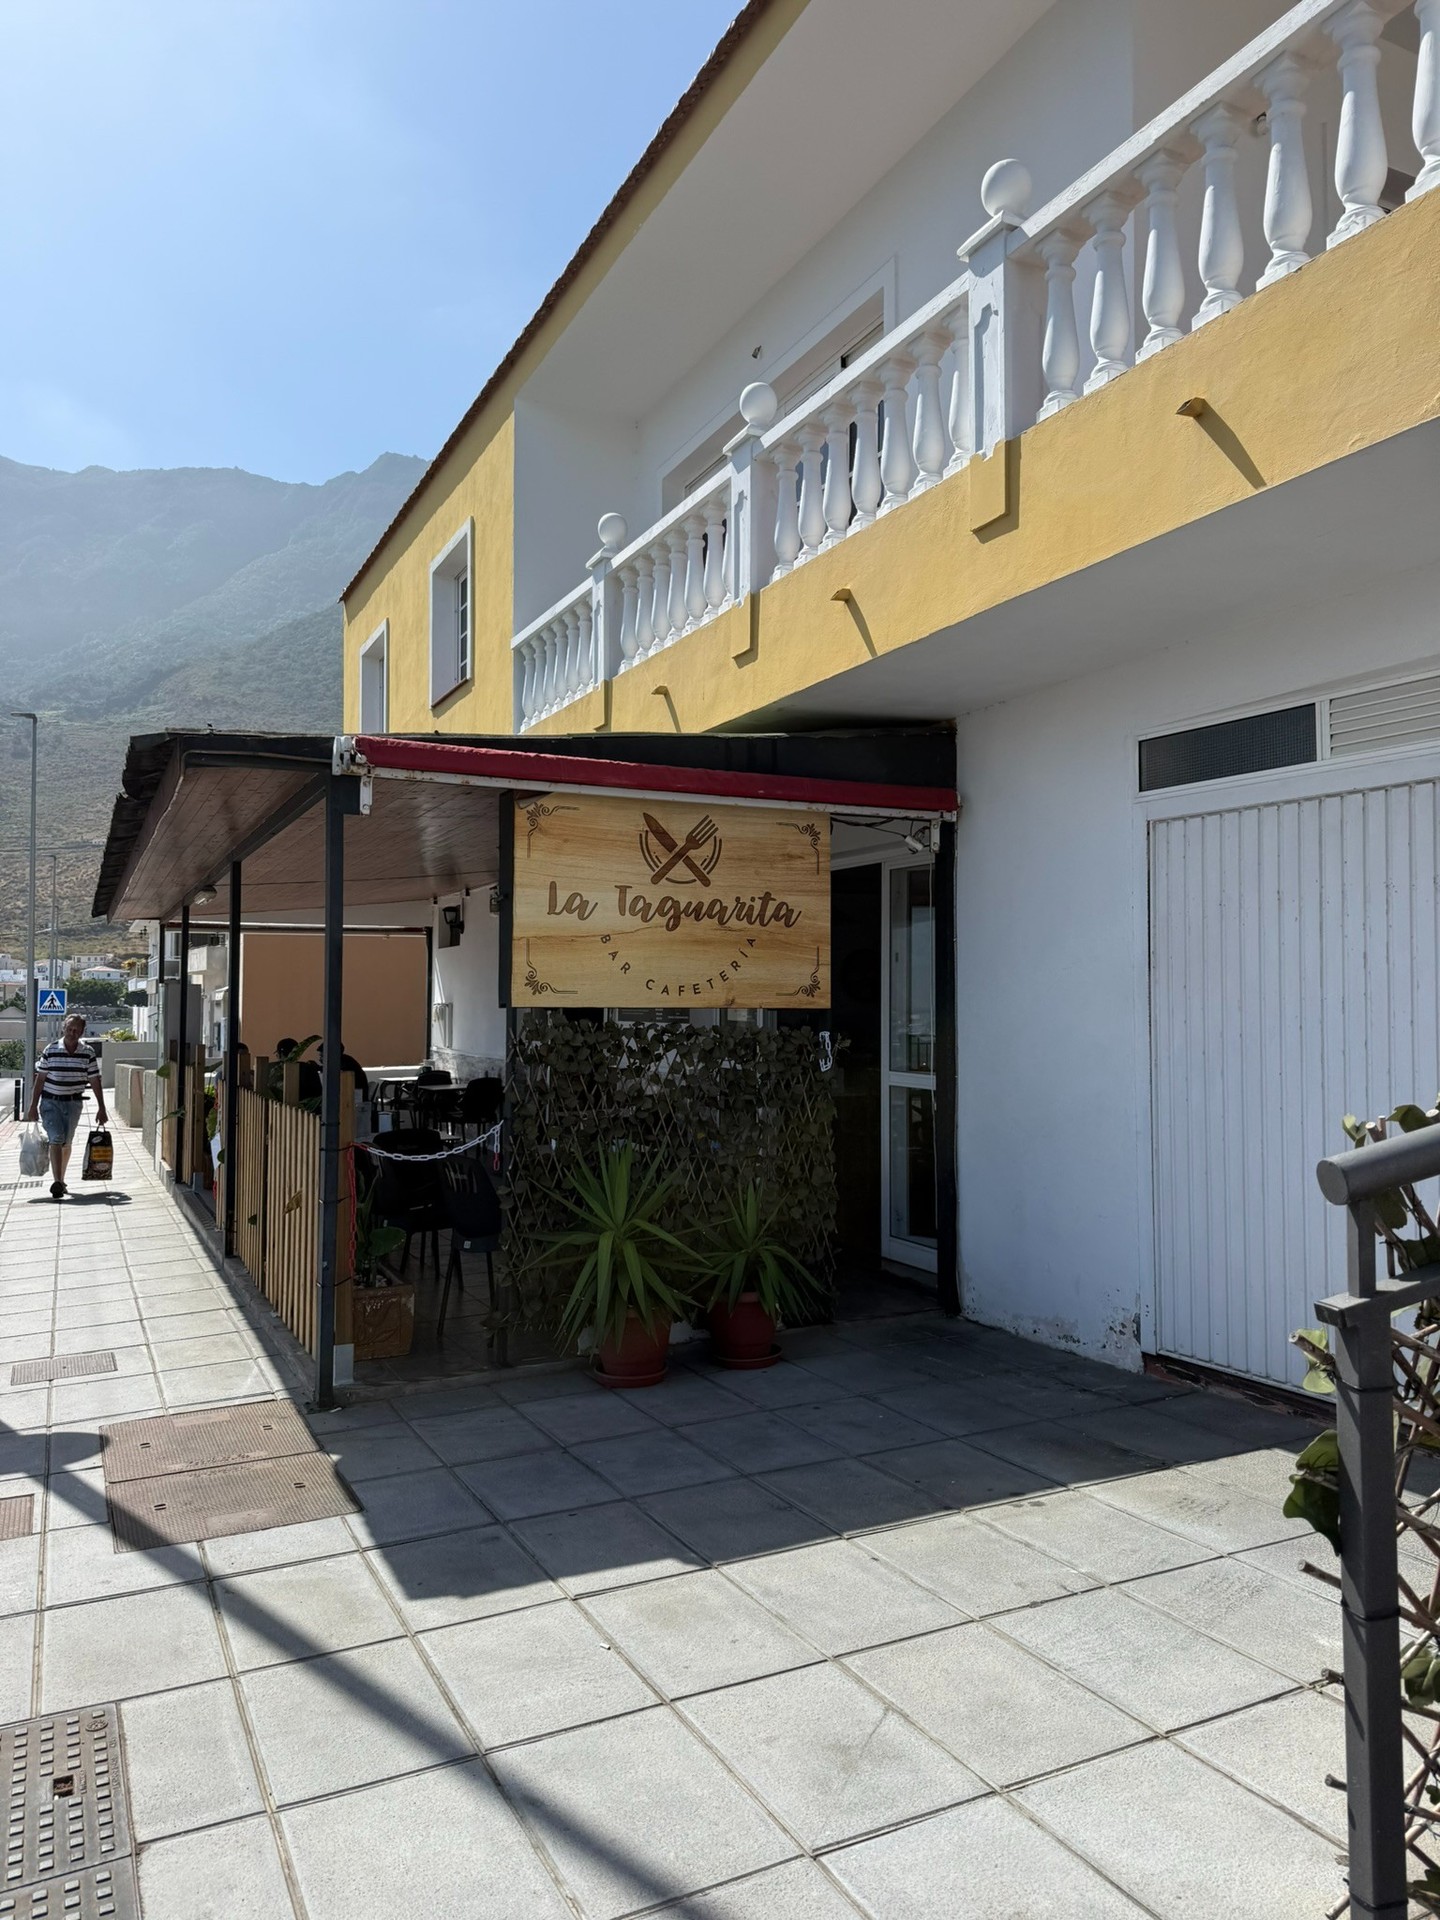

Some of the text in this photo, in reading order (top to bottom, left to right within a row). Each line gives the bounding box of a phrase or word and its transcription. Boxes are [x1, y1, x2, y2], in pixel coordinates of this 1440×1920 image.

[547, 880, 802, 932] La Taguarita
[600, 934, 757, 997] BAR CAFETERÍA
